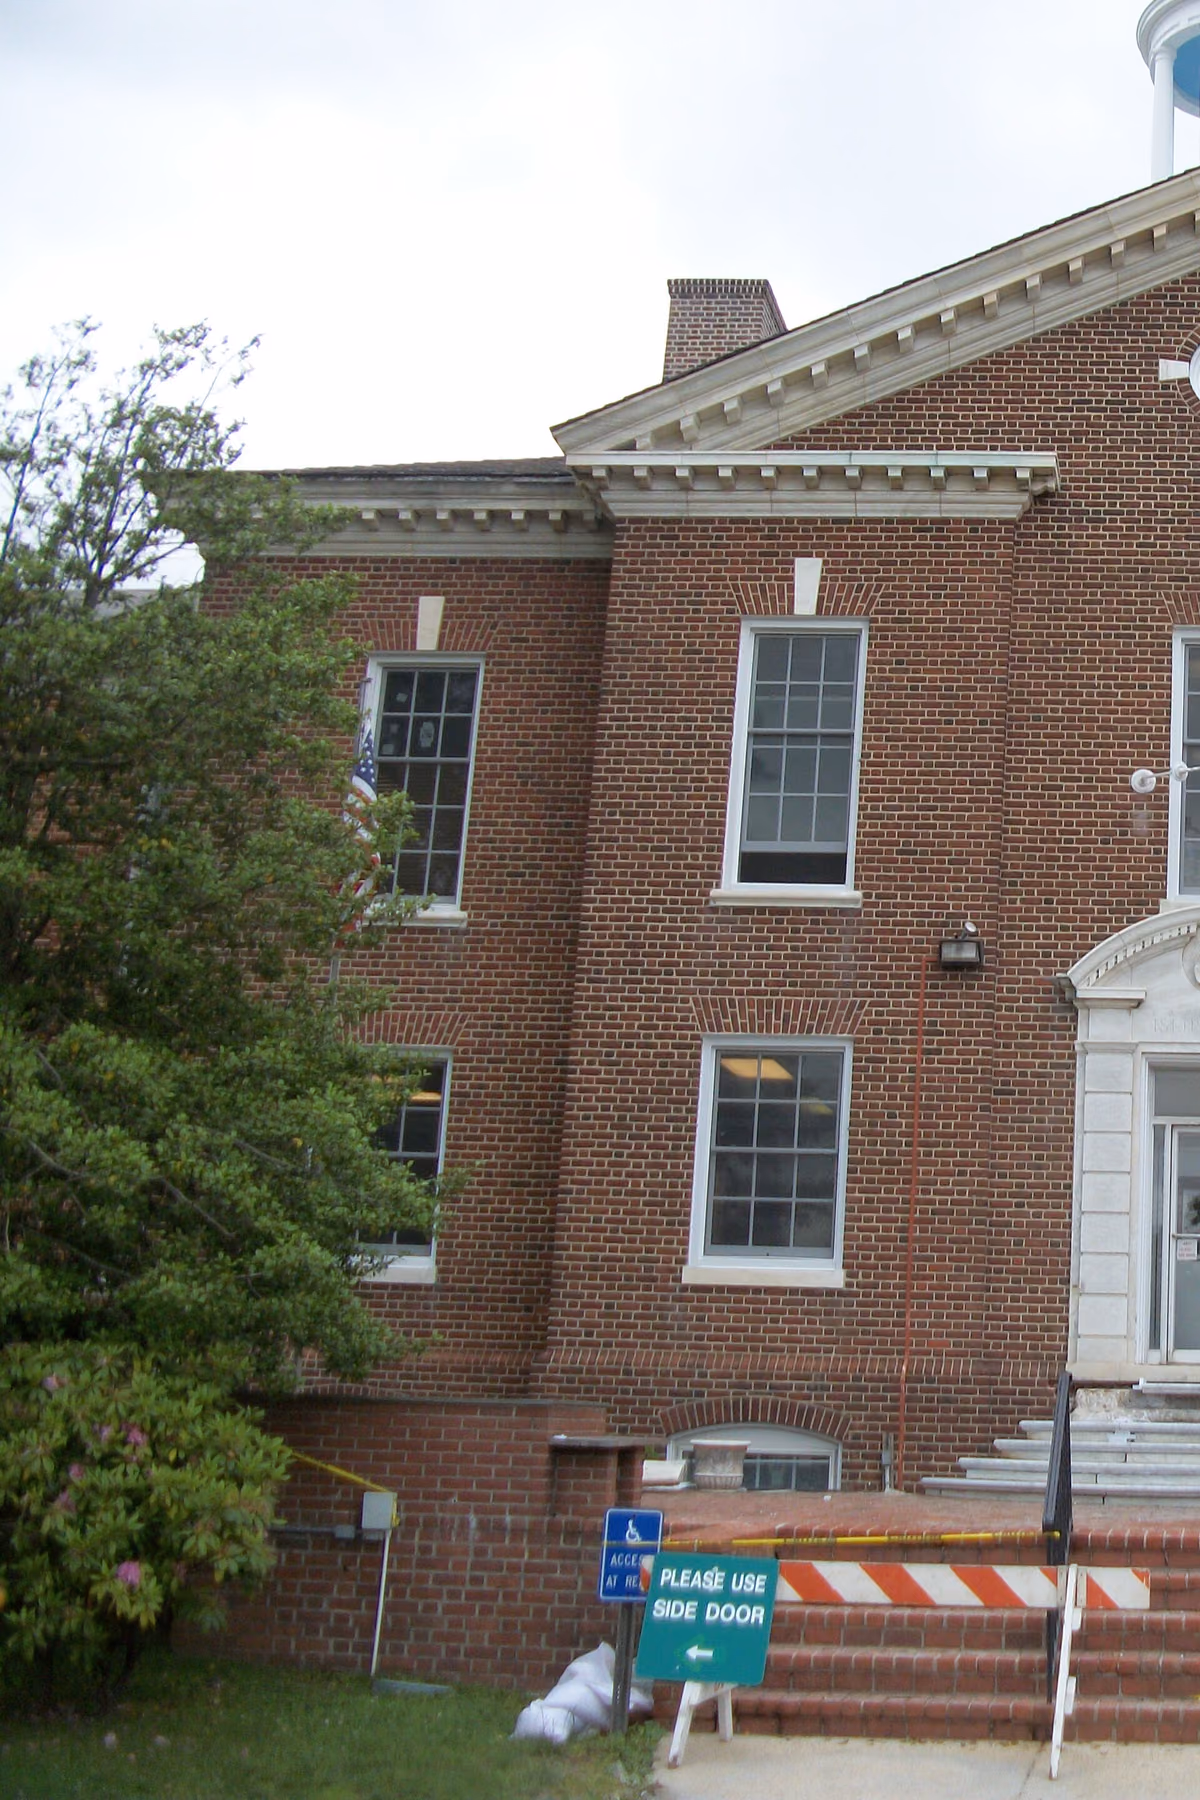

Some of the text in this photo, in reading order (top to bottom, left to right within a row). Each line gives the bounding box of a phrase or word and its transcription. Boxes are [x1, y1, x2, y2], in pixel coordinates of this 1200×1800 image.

[606, 1574, 618, 1588] AT
[660, 1567, 768, 1592] PLEASE USE
[652, 1599, 765, 1624] SIDE DOOR
